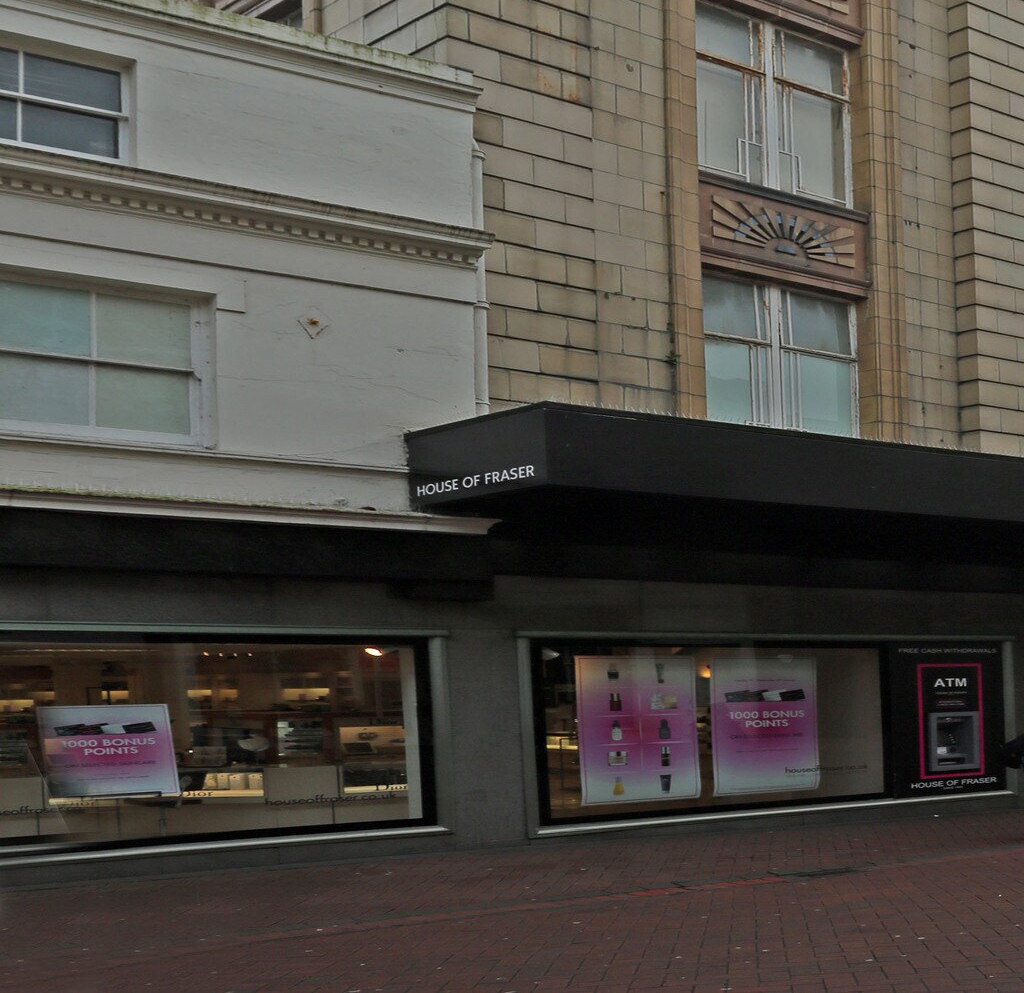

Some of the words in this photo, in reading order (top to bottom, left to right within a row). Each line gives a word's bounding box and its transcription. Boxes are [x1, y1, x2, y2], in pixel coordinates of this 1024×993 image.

[417, 479, 459, 496] HOUSE
[462, 475, 481, 488] OF
[485, 465, 534, 484] FRASER
[934, 677, 968, 688] ATM
[729, 711, 759, 719] 1000
[763, 709, 805, 718] BONUS
[745, 719, 789, 728] POINTS
[62, 739, 98, 748] 1000
[103, 737, 156, 747] BONUS
[84, 746, 139, 756] POINTS
[911, 780, 944, 789] HOUSE
[961, 776, 997, 785] FRASER
[265, 792, 397, 806] houseoffraser.co.uk
